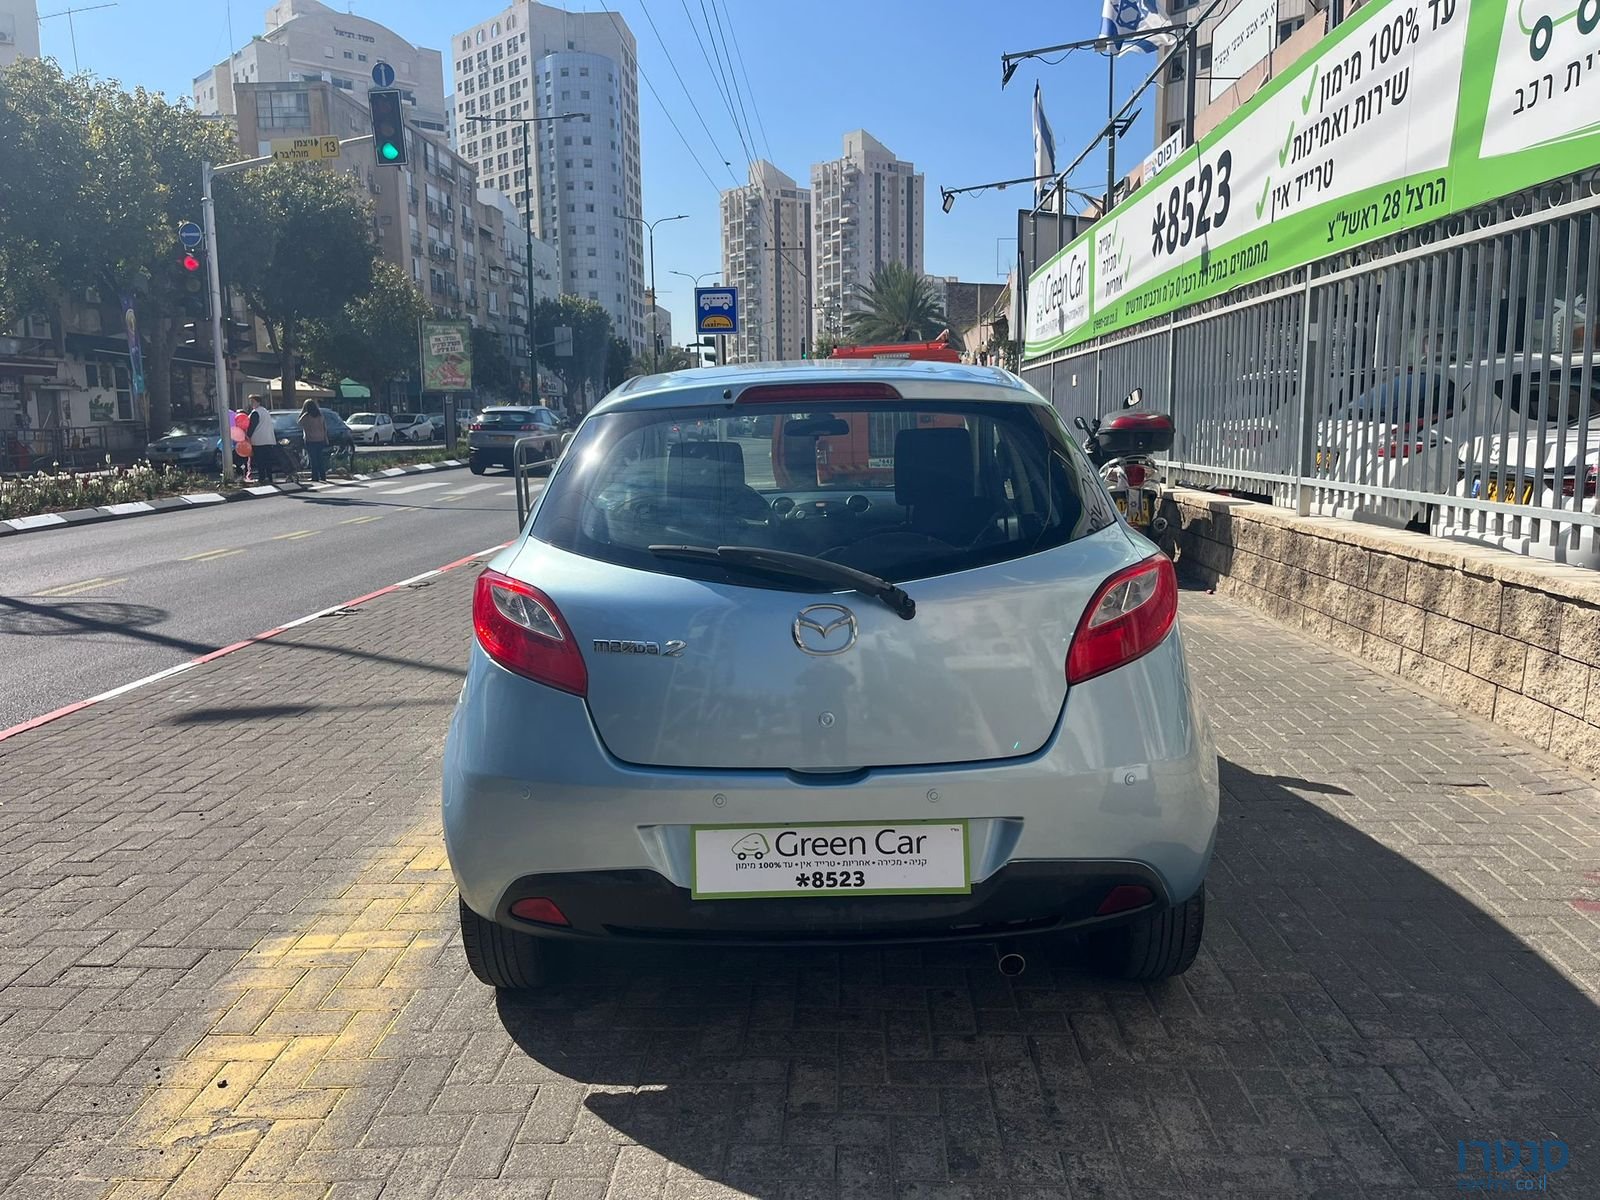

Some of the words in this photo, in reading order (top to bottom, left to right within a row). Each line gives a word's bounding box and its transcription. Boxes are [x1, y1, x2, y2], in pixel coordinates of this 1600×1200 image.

[1428, 0, 1457, 31] עד
[1369, 7, 1419, 71] 100%
[1319, 50, 1362, 114] מימון
[1512, 73, 1553, 115] רכב
[1352, 66, 1410, 130] שירות
[293, 138, 314, 150] ויצמן
[323, 141, 337, 153] 13
[1291, 104, 1350, 165] ואמינות
[1157, 137, 1178, 168] דפוס
[1295, 158, 1334, 202] טרייד
[1270, 181, 1291, 223] אין
[1381, 189, 1402, 224] 28
[1405, 178, 1447, 215] הרצל
[1327, 203, 1379, 243] ראשל"צ
[1230, 239, 1269, 276] מתמחים
[1044, 272, 1068, 315] Green
[1069, 253, 1087, 301] Car
[1181, 271, 1197, 295] רכבי
[1197, 258, 1228, 289] במכירת
[661, 639, 688, 658] 2
[774, 830, 867, 858] Green
[874, 828, 927, 856] Car
[735, 862, 756, 871] מימון
[758, 861, 782, 869] 100%
[783, 861, 794, 869] עד
[800, 860, 812, 870] אין
[815, 859, 836, 868] טרייד
[842, 858, 872, 868] אחריות
[877, 858, 903, 867] מכירה
[908, 857, 928, 868] קניה
